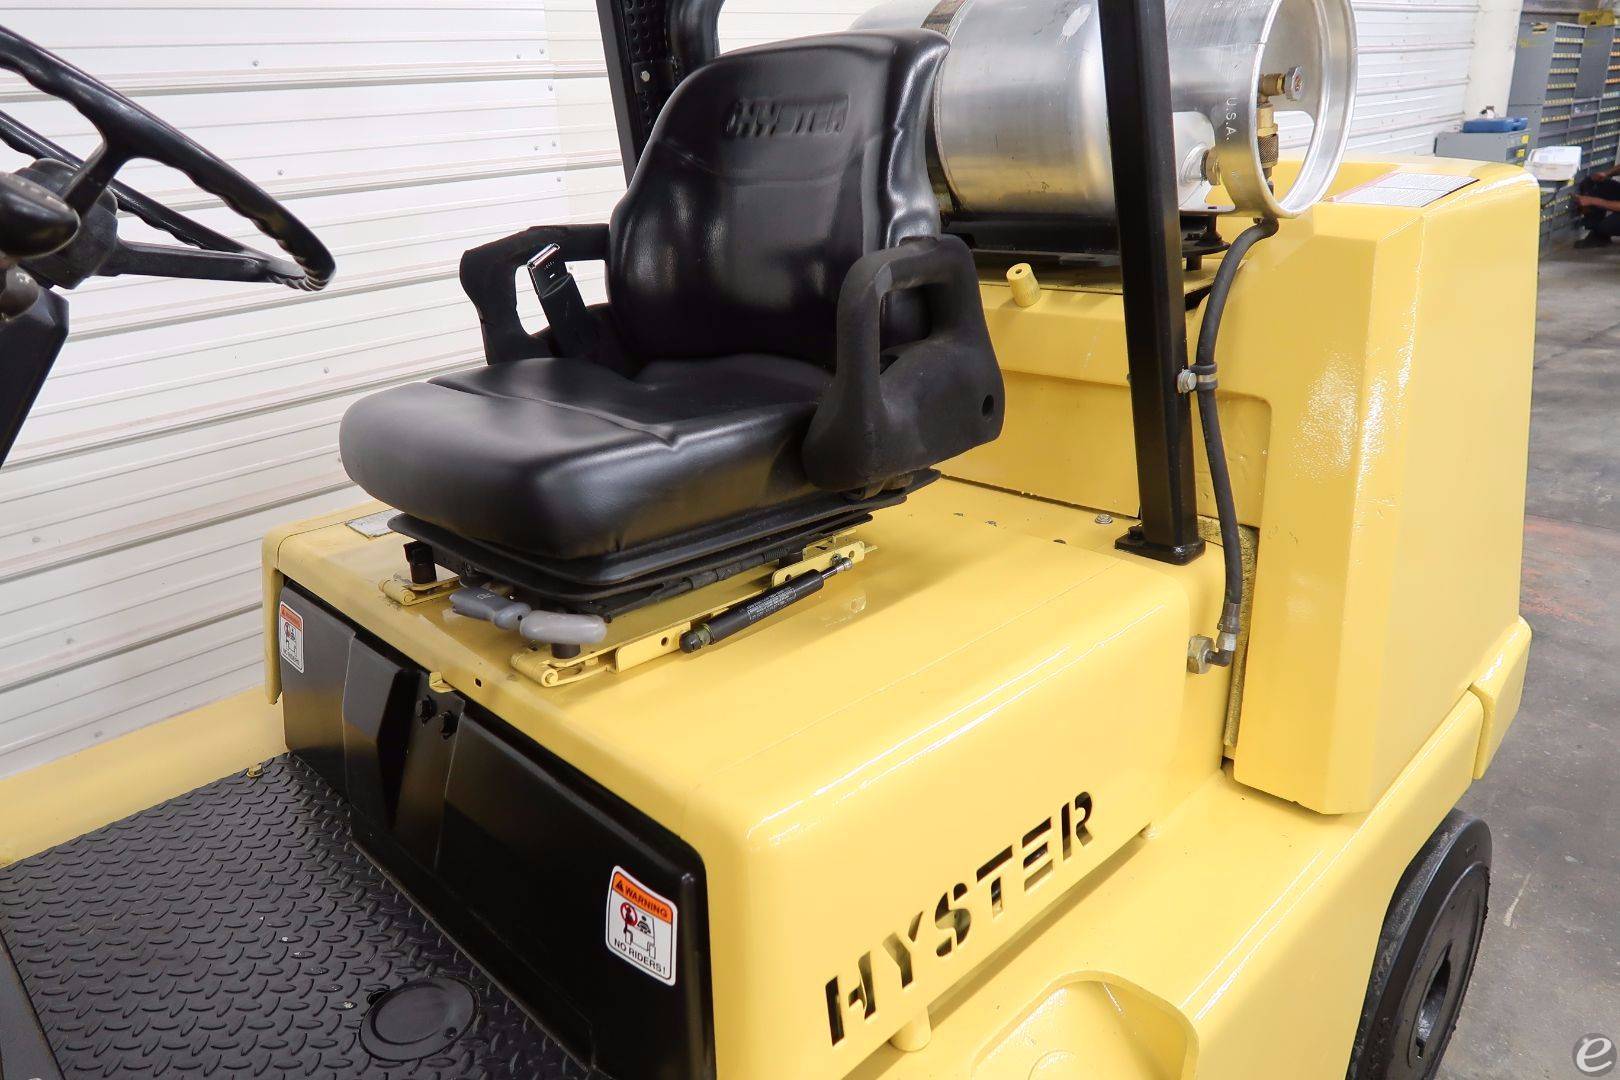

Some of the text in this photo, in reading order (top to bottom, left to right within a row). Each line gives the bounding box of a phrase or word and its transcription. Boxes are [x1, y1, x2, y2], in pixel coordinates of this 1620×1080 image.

[625, 887, 668, 917] WARNING
[825, 791, 1093, 1046] HYSTER
[614, 938, 627, 951] NO
